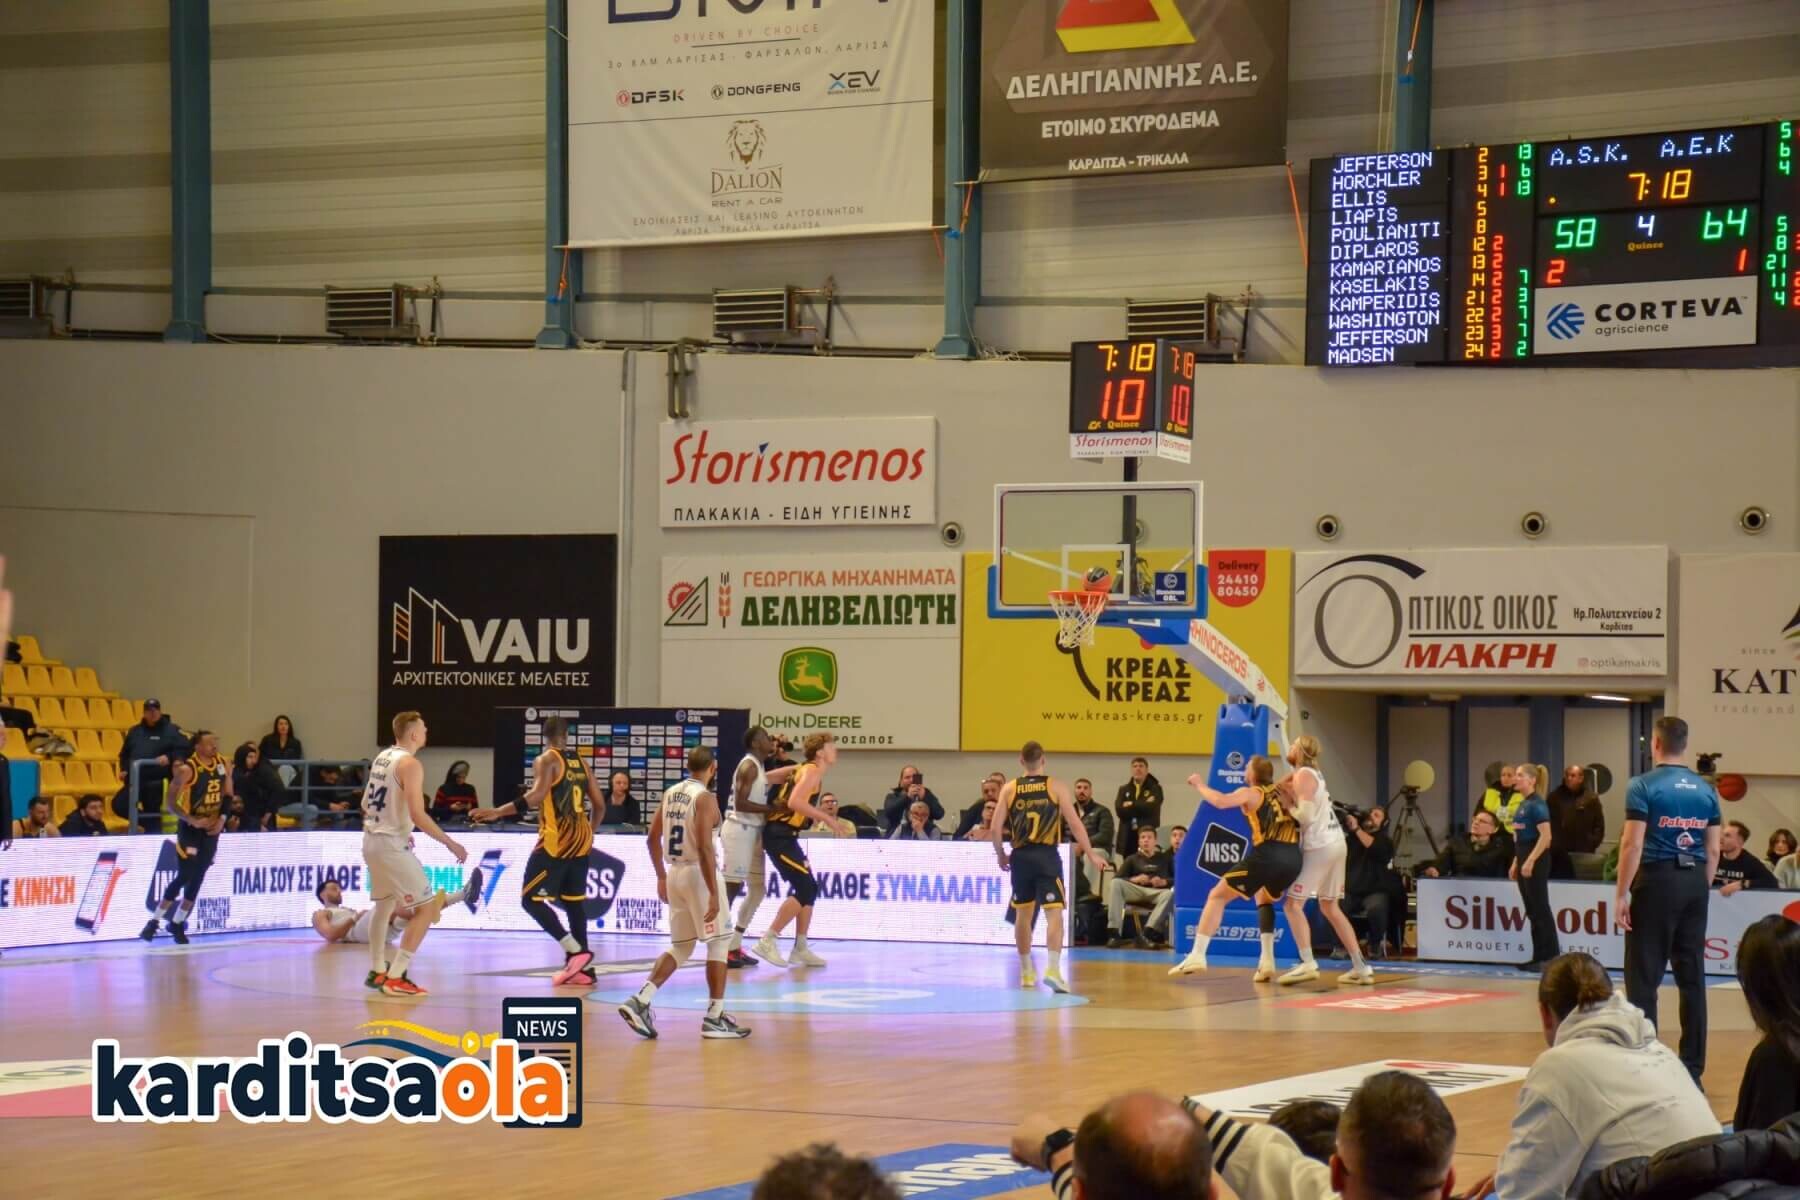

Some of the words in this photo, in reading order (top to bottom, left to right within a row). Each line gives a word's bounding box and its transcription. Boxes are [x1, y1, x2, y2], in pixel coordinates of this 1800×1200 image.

[673, 31, 726, 44] DRIVEN
[764, 23, 819, 37] CHOICE
[727, 82, 801, 97] DONGFENG
[829, 69, 880, 89] XEV
[1005, 62, 1202, 100] ΔΕΛΗΓΙΑΝΝΗΣ
[1209, 61, 1258, 86] Α.Ε.
[632, 88, 685, 104] DFSK
[1041, 117, 1106, 138] ΕΤΟΙΜΟ
[1109, 110, 1219, 134] ΣΚΥΡΟΔΕΜΑ
[1780, 122, 1791, 139] 5
[1550, 143, 1628, 166] A.S.K.
[1660, 133, 1734, 158] A.E.K
[1068, 155, 1126, 170] ΚΑΡΔΙΤΣΑ
[1136, 152, 1189, 168] ΤΡΙΚΑΛΑ
[1333, 152, 1433, 173] JEFFERSON
[1478, 147, 1488, 162] 2
[1518, 144, 1532, 160] 13
[1779, 160, 1790, 175] 4
[711, 167, 783, 194] DALION
[1332, 171, 1421, 191] HORCHLER
[1478, 165, 1488, 180] 3
[1500, 164, 1505, 179] 1
[1629, 169, 1692, 200] 7:18
[712, 200, 740, 208] RENT
[760, 197, 783, 205] CAR
[1332, 191, 1387, 208] ELLIS
[1477, 184, 1487, 197] 4
[1500, 182, 1505, 196] 1
[1517, 180, 1530, 195] 13
[1331, 207, 1398, 225] LIAPIS
[1477, 201, 1487, 216] 5
[1702, 208, 1748, 240] 64
[1777, 216, 1787, 232] 5
[1331, 222, 1440, 243] POULIANITI
[1476, 219, 1486, 234] 8
[1555, 217, 1597, 248] 58
[1638, 214, 1655, 237] 4
[1331, 241, 1419, 260] DIPLAROS
[1473, 238, 1485, 252] 12
[1493, 235, 1503, 251] 2
[1776, 235, 1787, 251] 8
[1330, 257, 1441, 277] KAMARIANOS
[1473, 255, 1485, 269] 13
[1492, 253, 1503, 268] 2
[1547, 259, 1565, 284] 2
[1738, 249, 1748, 271] 1
[1766, 254, 1786, 270] 21
[1330, 276, 1429, 295] KASELAKIS
[1472, 273, 1485, 286] 14
[1492, 271, 1503, 287] 2
[1519, 269, 1528, 284] 7
[1772, 273, 1786, 288] 11
[1329, 293, 1440, 312] KAMPERIDIS
[1466, 290, 1485, 305] 21
[1492, 289, 1502, 305] 2
[1519, 288, 1528, 302] 3
[1595, 297, 1742, 323] CORTEVA
[1774, 291, 1785, 306] 4
[1328, 310, 1440, 329] WASHINGTON
[1466, 308, 1484, 323] 22
[1492, 306, 1502, 322] 2
[1519, 305, 1527, 319] 7
[1595, 322, 1669, 336] agriscience
[1328, 328, 1428, 347] JEFFERSON
[1465, 326, 1484, 341] 23
[1491, 324, 1501, 340] 3
[1518, 323, 1527, 337] 7
[1098, 344, 1155, 371] 7:18
[1171, 346, 1194, 380] 7:18
[1328, 346, 1394, 364] MADSEN
[1465, 344, 1483, 358] 24
[1491, 342, 1501, 358] 2
[1517, 341, 1526, 356] 2
[1102, 380, 1145, 420] 10
[1171, 384, 1190, 426] 10
[667, 430, 926, 485] Storismenos
[674, 507, 760, 521] ΠΛΑΚΑΚΙΑ
[783, 506, 822, 520] ΕΙΔΗ
[832, 505, 911, 519] ΥΓΙΕΙΝΗΣ
[743, 571, 826, 587] ΓΕΩΡΓΙΚΑ
[832, 568, 956, 586] ΜΗΧΑΝΗΜΑΤΑ
[1218, 560, 1260, 572] Delivery
[741, 594, 956, 626] ΔΕΛΗΒΕΛΙΩΤΗ
[1494, 595, 1558, 630] ΟΙΚΟΣ
[1655, 608, 1662, 619] 2
[460, 618, 590, 664] VAIU
[1106, 658, 1191, 678] ΚΡΕΑΣ
[1404, 644, 1558, 669] ΜΑΚΡΗ
[392, 671, 516, 687] ΑΡΧΙΤΕΚΤΟΝΙΚΕΣ
[520, 672, 590, 687] ΜΕΛΕΤΕΣ
[1712, 668, 1800, 694] KAT
[1106, 681, 1191, 702] ΚΡΕΑΣ
[758, 713, 800, 728] JOHN
[803, 713, 862, 728] DEERE
[1041, 711, 1204, 724] www.kreas-kreas.gr
[1026, 811, 1040, 840] 7
[669, 825, 684, 856] 2
[1205, 843, 1240, 863] INSS
[14, 876, 75, 906] ΚΙΝΗΣΗ
[270, 866, 295, 892] ΣΟΥ
[298, 866, 312, 891] ΣΕ
[816, 872, 870, 900] ΚΑΘΕ
[876, 873, 1000, 904] ΣΥΝΑΛΛΑΓΗ
[1445, 895, 1608, 936] Silwod
[1448, 940, 1511, 952] PARQUET
[1518, 944, 1525, 952] &
